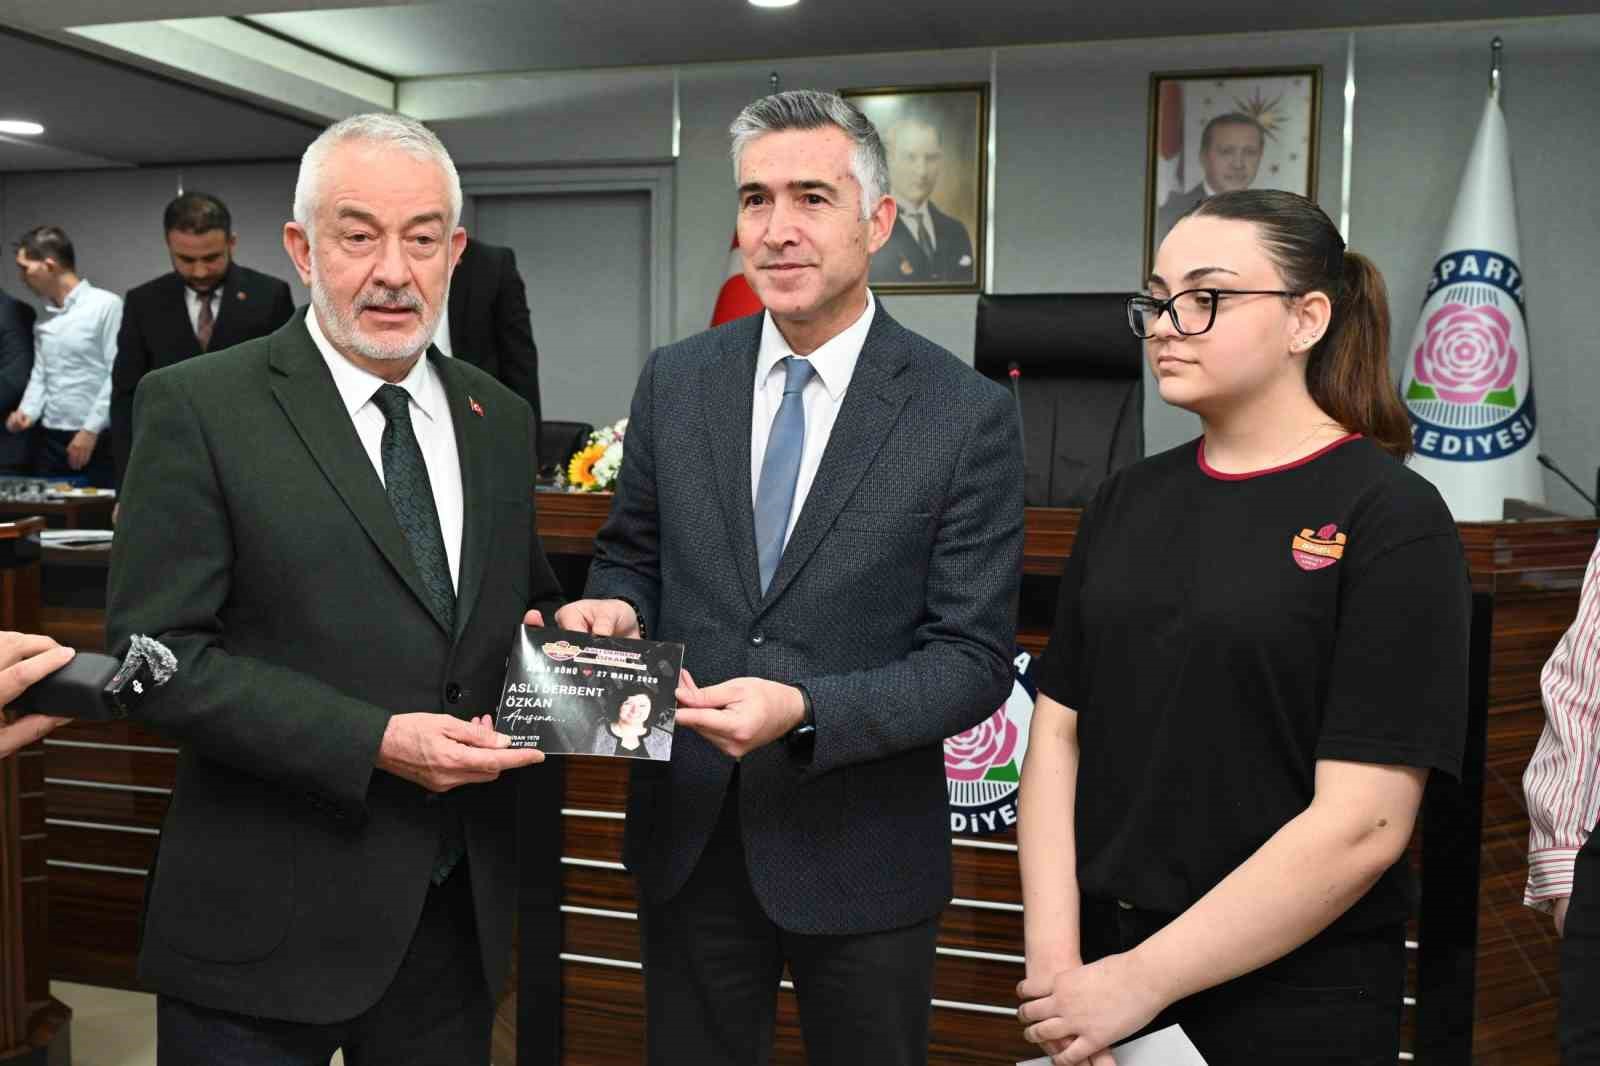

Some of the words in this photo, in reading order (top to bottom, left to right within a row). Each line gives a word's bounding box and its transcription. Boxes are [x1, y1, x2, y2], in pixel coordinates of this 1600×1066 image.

[508, 683, 539, 694] ASLI
[542, 684, 605, 698] DERBENT
[505, 695, 553, 708] ÖZKAN
